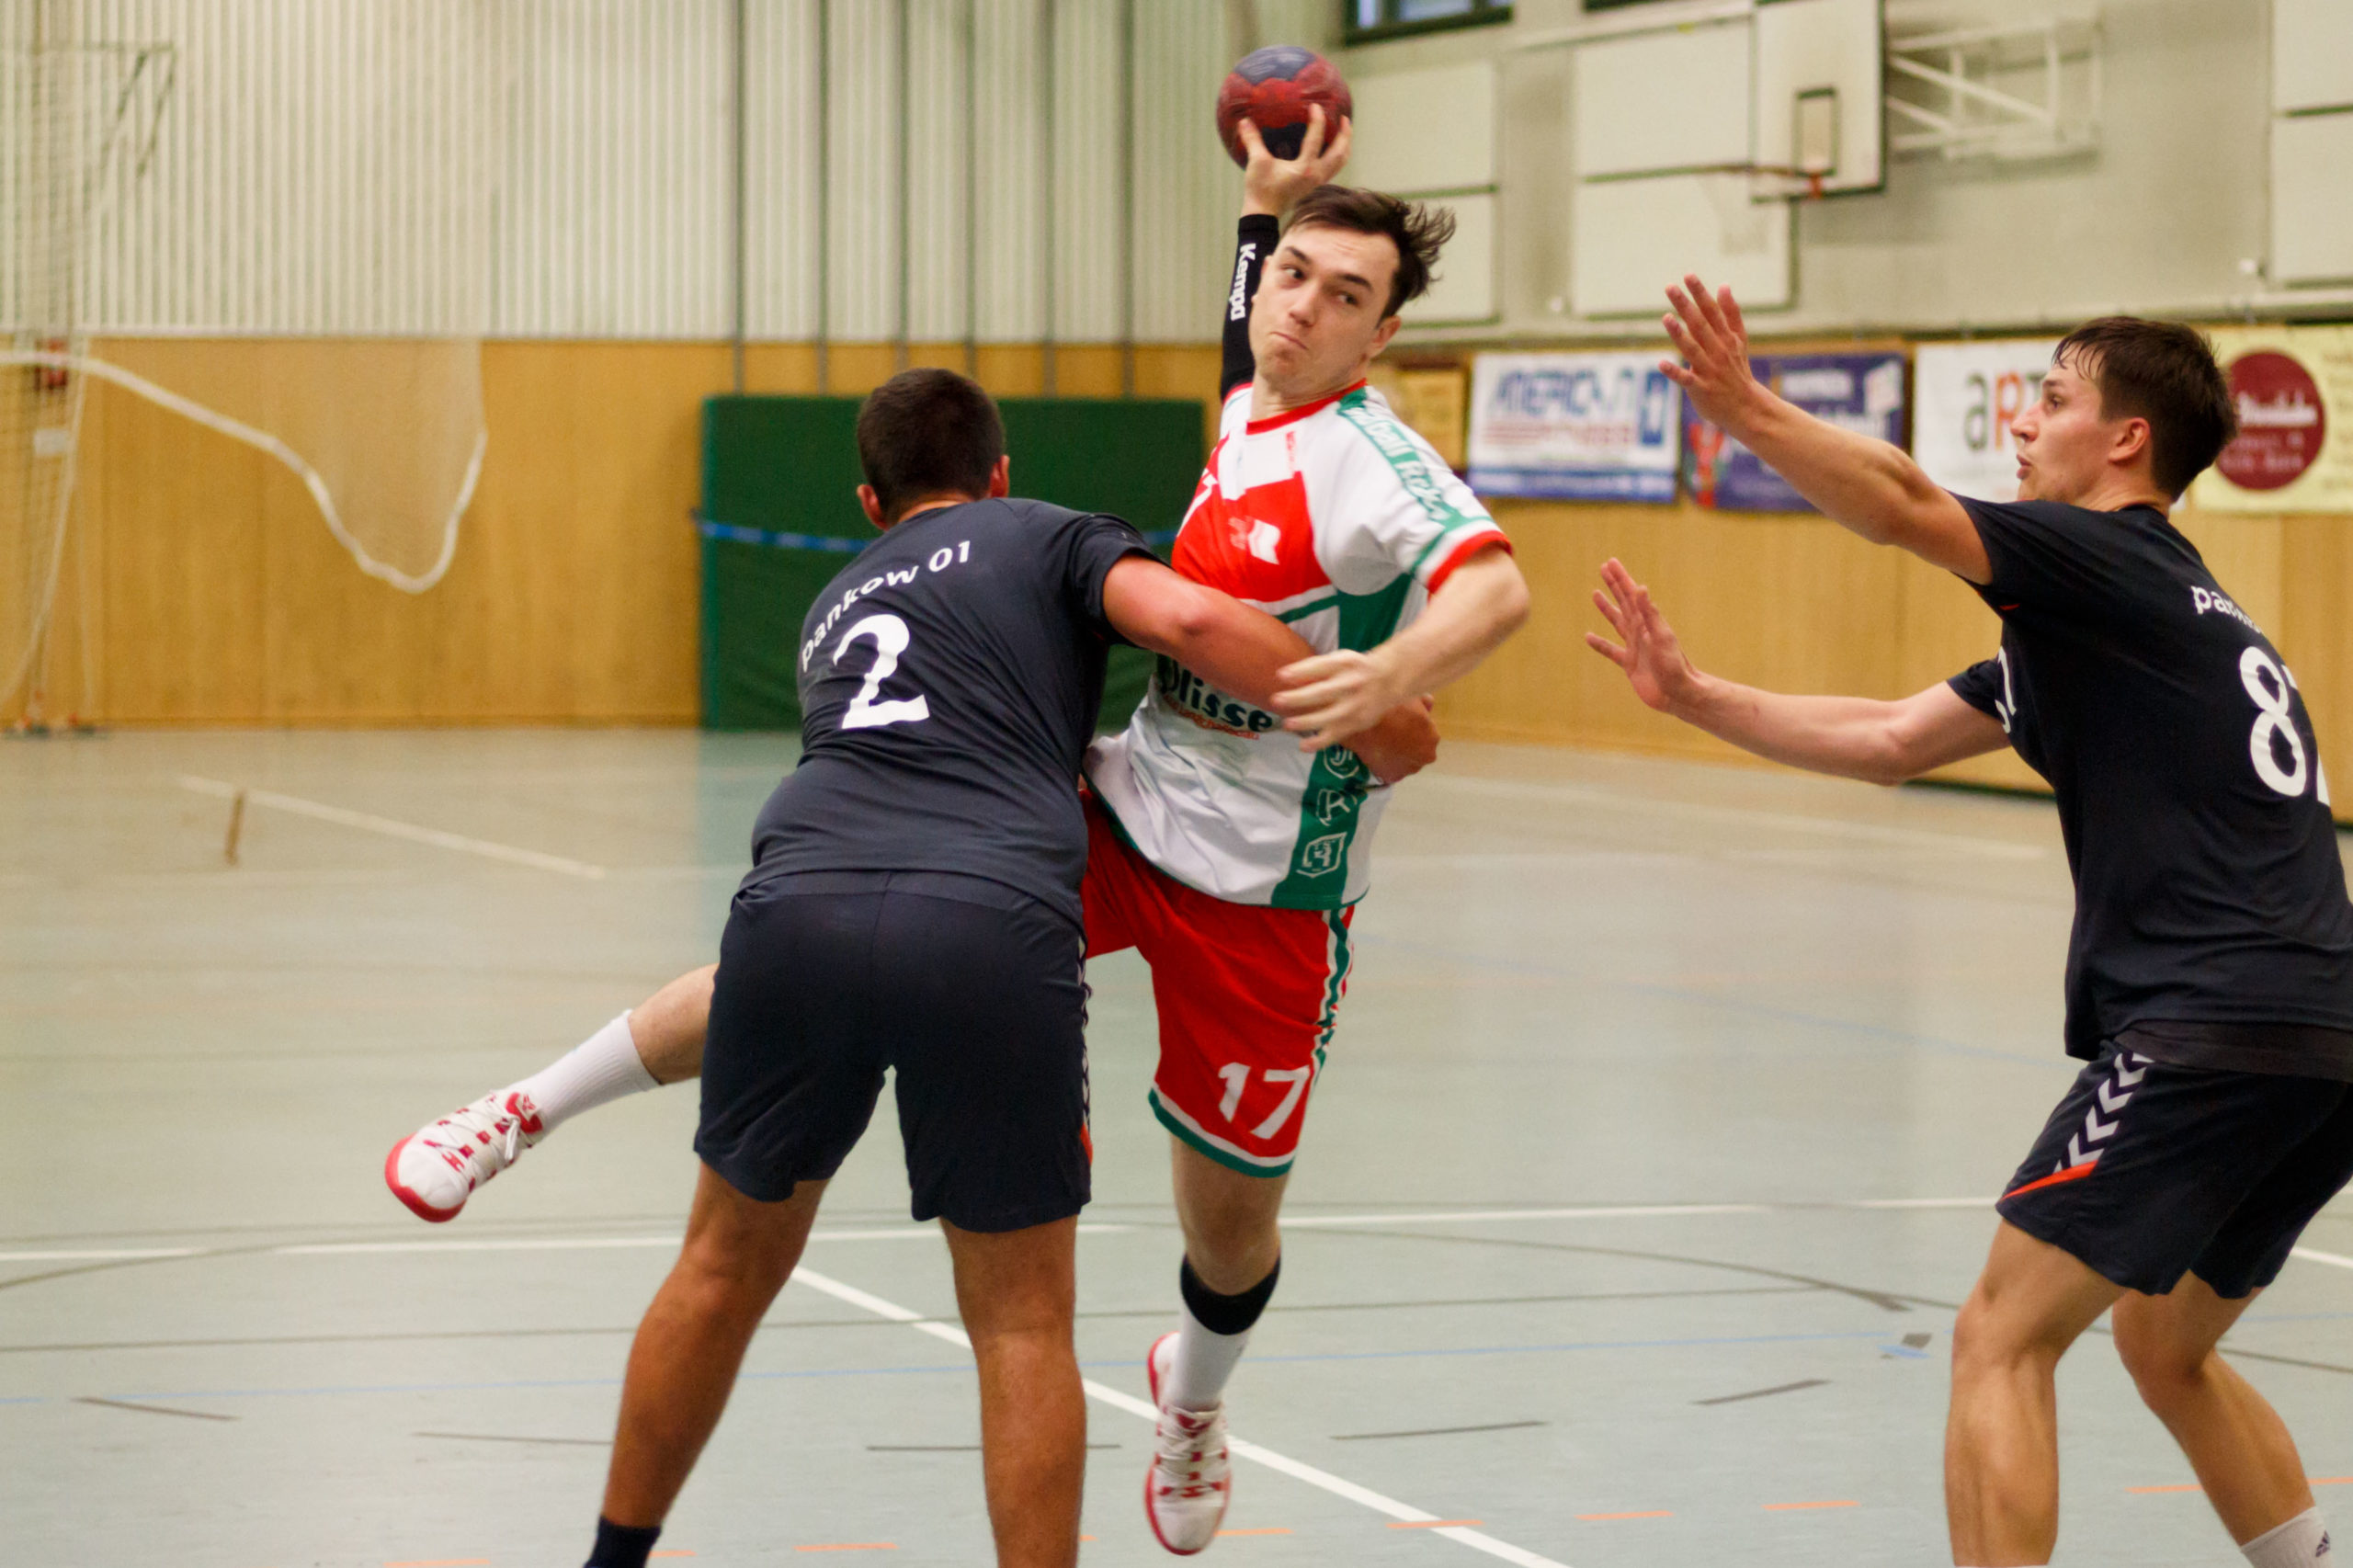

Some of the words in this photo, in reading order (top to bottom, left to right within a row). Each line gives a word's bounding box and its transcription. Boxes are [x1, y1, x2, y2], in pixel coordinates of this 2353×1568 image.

[1229, 243, 1256, 321] Kempa
[801, 565, 919, 673] pankow
[928, 540, 971, 573] 01
[833, 613, 930, 730] 2
[2239, 645, 2331, 808] 8
[1218, 1062, 1311, 1140] 17
